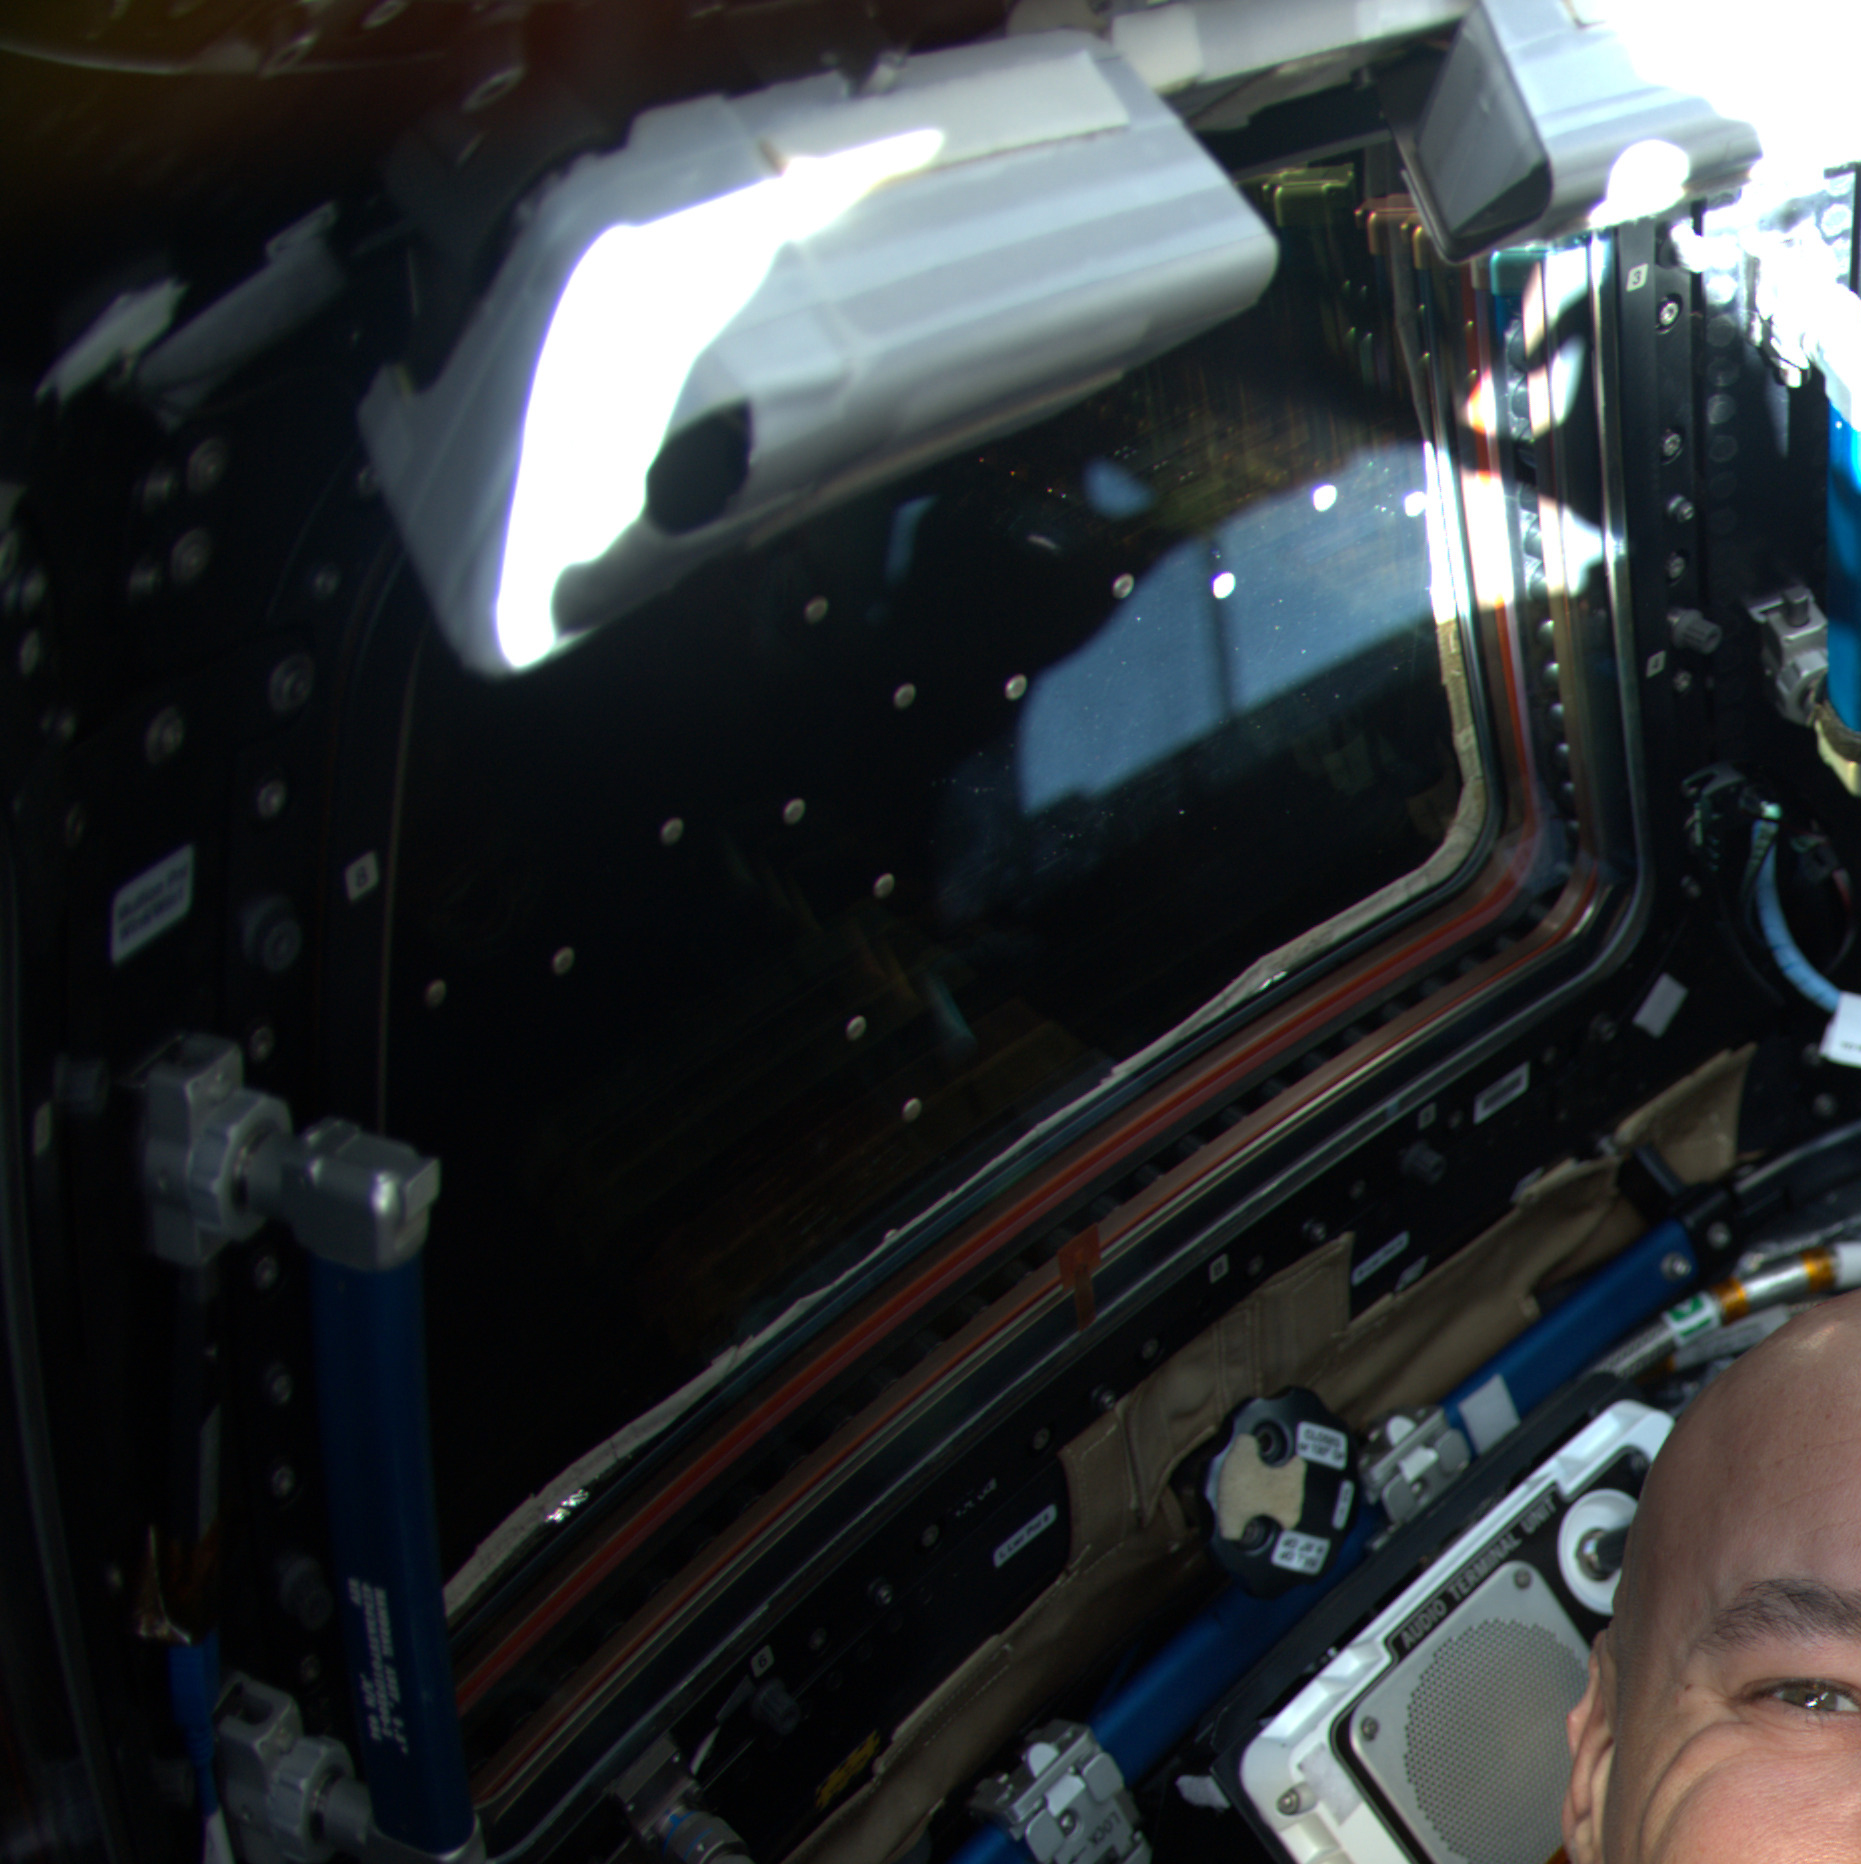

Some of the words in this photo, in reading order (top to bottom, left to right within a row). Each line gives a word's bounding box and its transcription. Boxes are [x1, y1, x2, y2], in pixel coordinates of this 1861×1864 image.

[1632, 270, 1642, 286] 3
[1398, 1594, 1449, 1650] AUDIO
[1447, 1524, 1524, 1603] TERMINAL
[1508, 1495, 1560, 1550] UNIT
